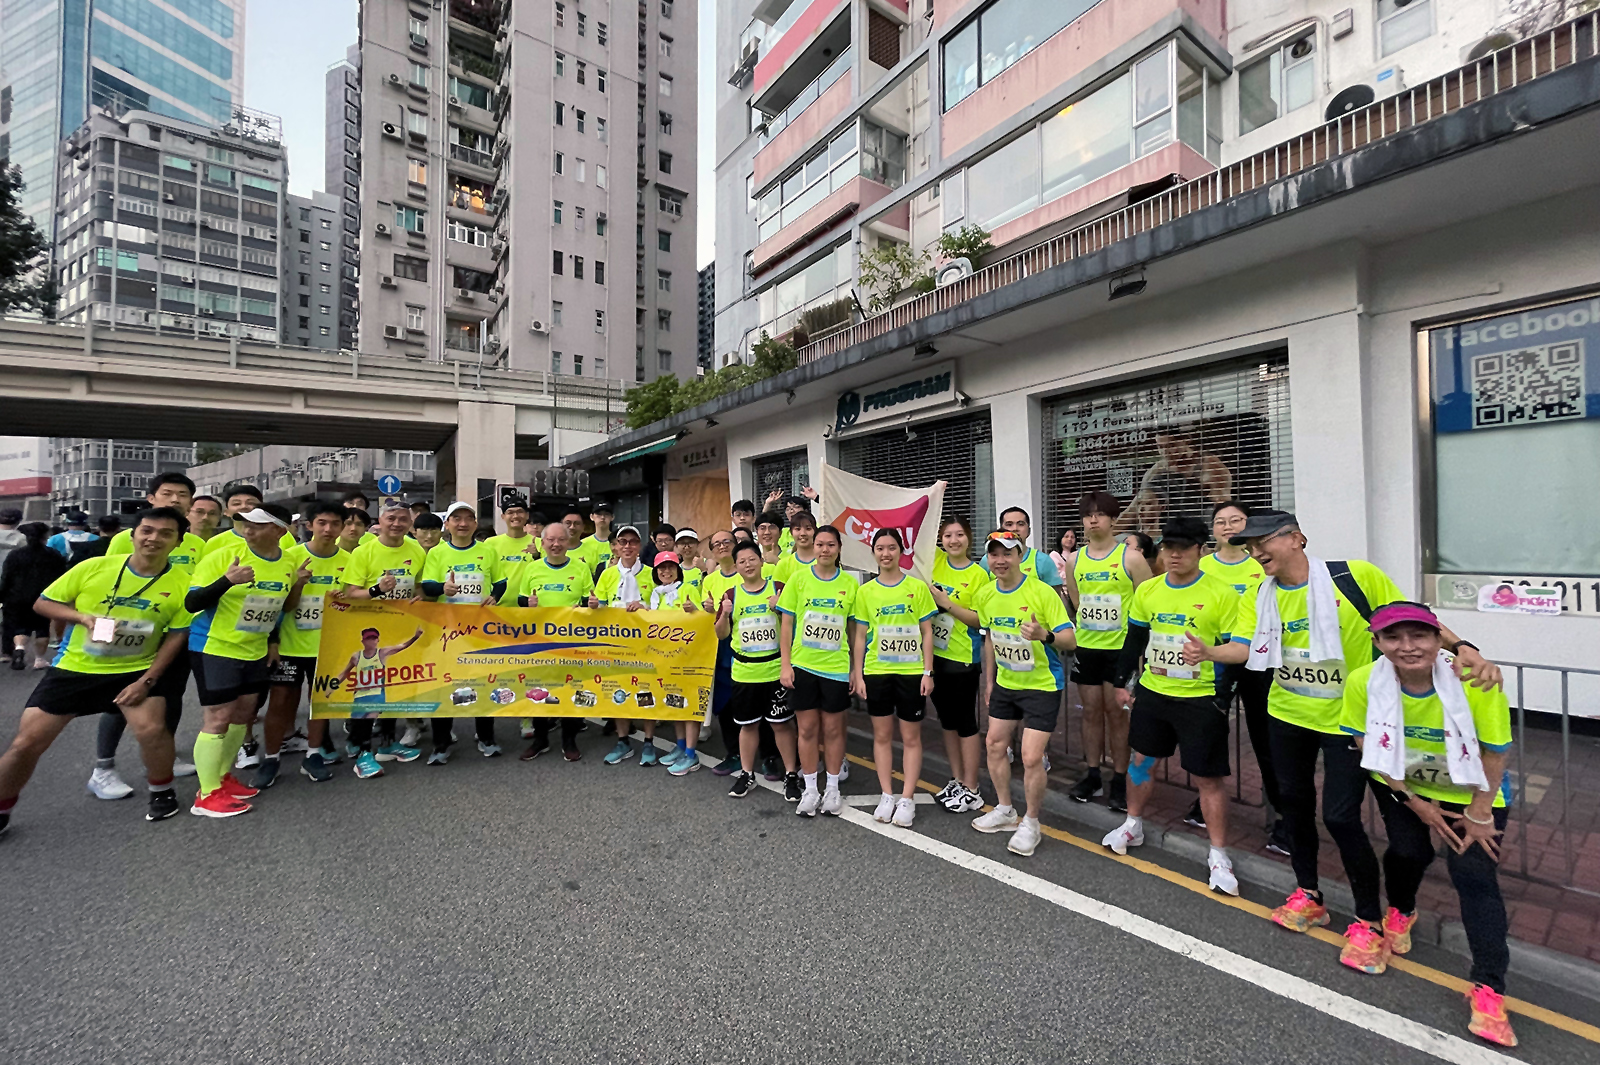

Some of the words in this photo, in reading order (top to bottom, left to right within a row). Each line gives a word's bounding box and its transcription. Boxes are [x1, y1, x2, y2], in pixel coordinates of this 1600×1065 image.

[1072, 420, 1088, 432] TO
[457, 584, 482, 596] 4529
[243, 608, 279, 623] S450
[1081, 607, 1118, 621] S4513
[440, 622, 478, 652] join
[482, 621, 537, 638] CityU
[544, 622, 642, 640] Delegation
[646, 623, 696, 645] 2024
[741, 628, 776, 644] S4690
[804, 624, 841, 641] S4700
[880, 639, 918, 652] S4709
[994, 643, 1031, 661] S4710
[457, 656, 505, 665] Standard
[507, 656, 556, 665] Chartered
[558, 658, 584, 668] Hong
[587, 658, 611, 668] Kong
[613, 658, 655, 669] Marathon
[1152, 648, 1186, 667] T428
[314, 674, 340, 693] We
[346, 662, 437, 688] SUPPORT
[1277, 664, 1343, 685] S4504
